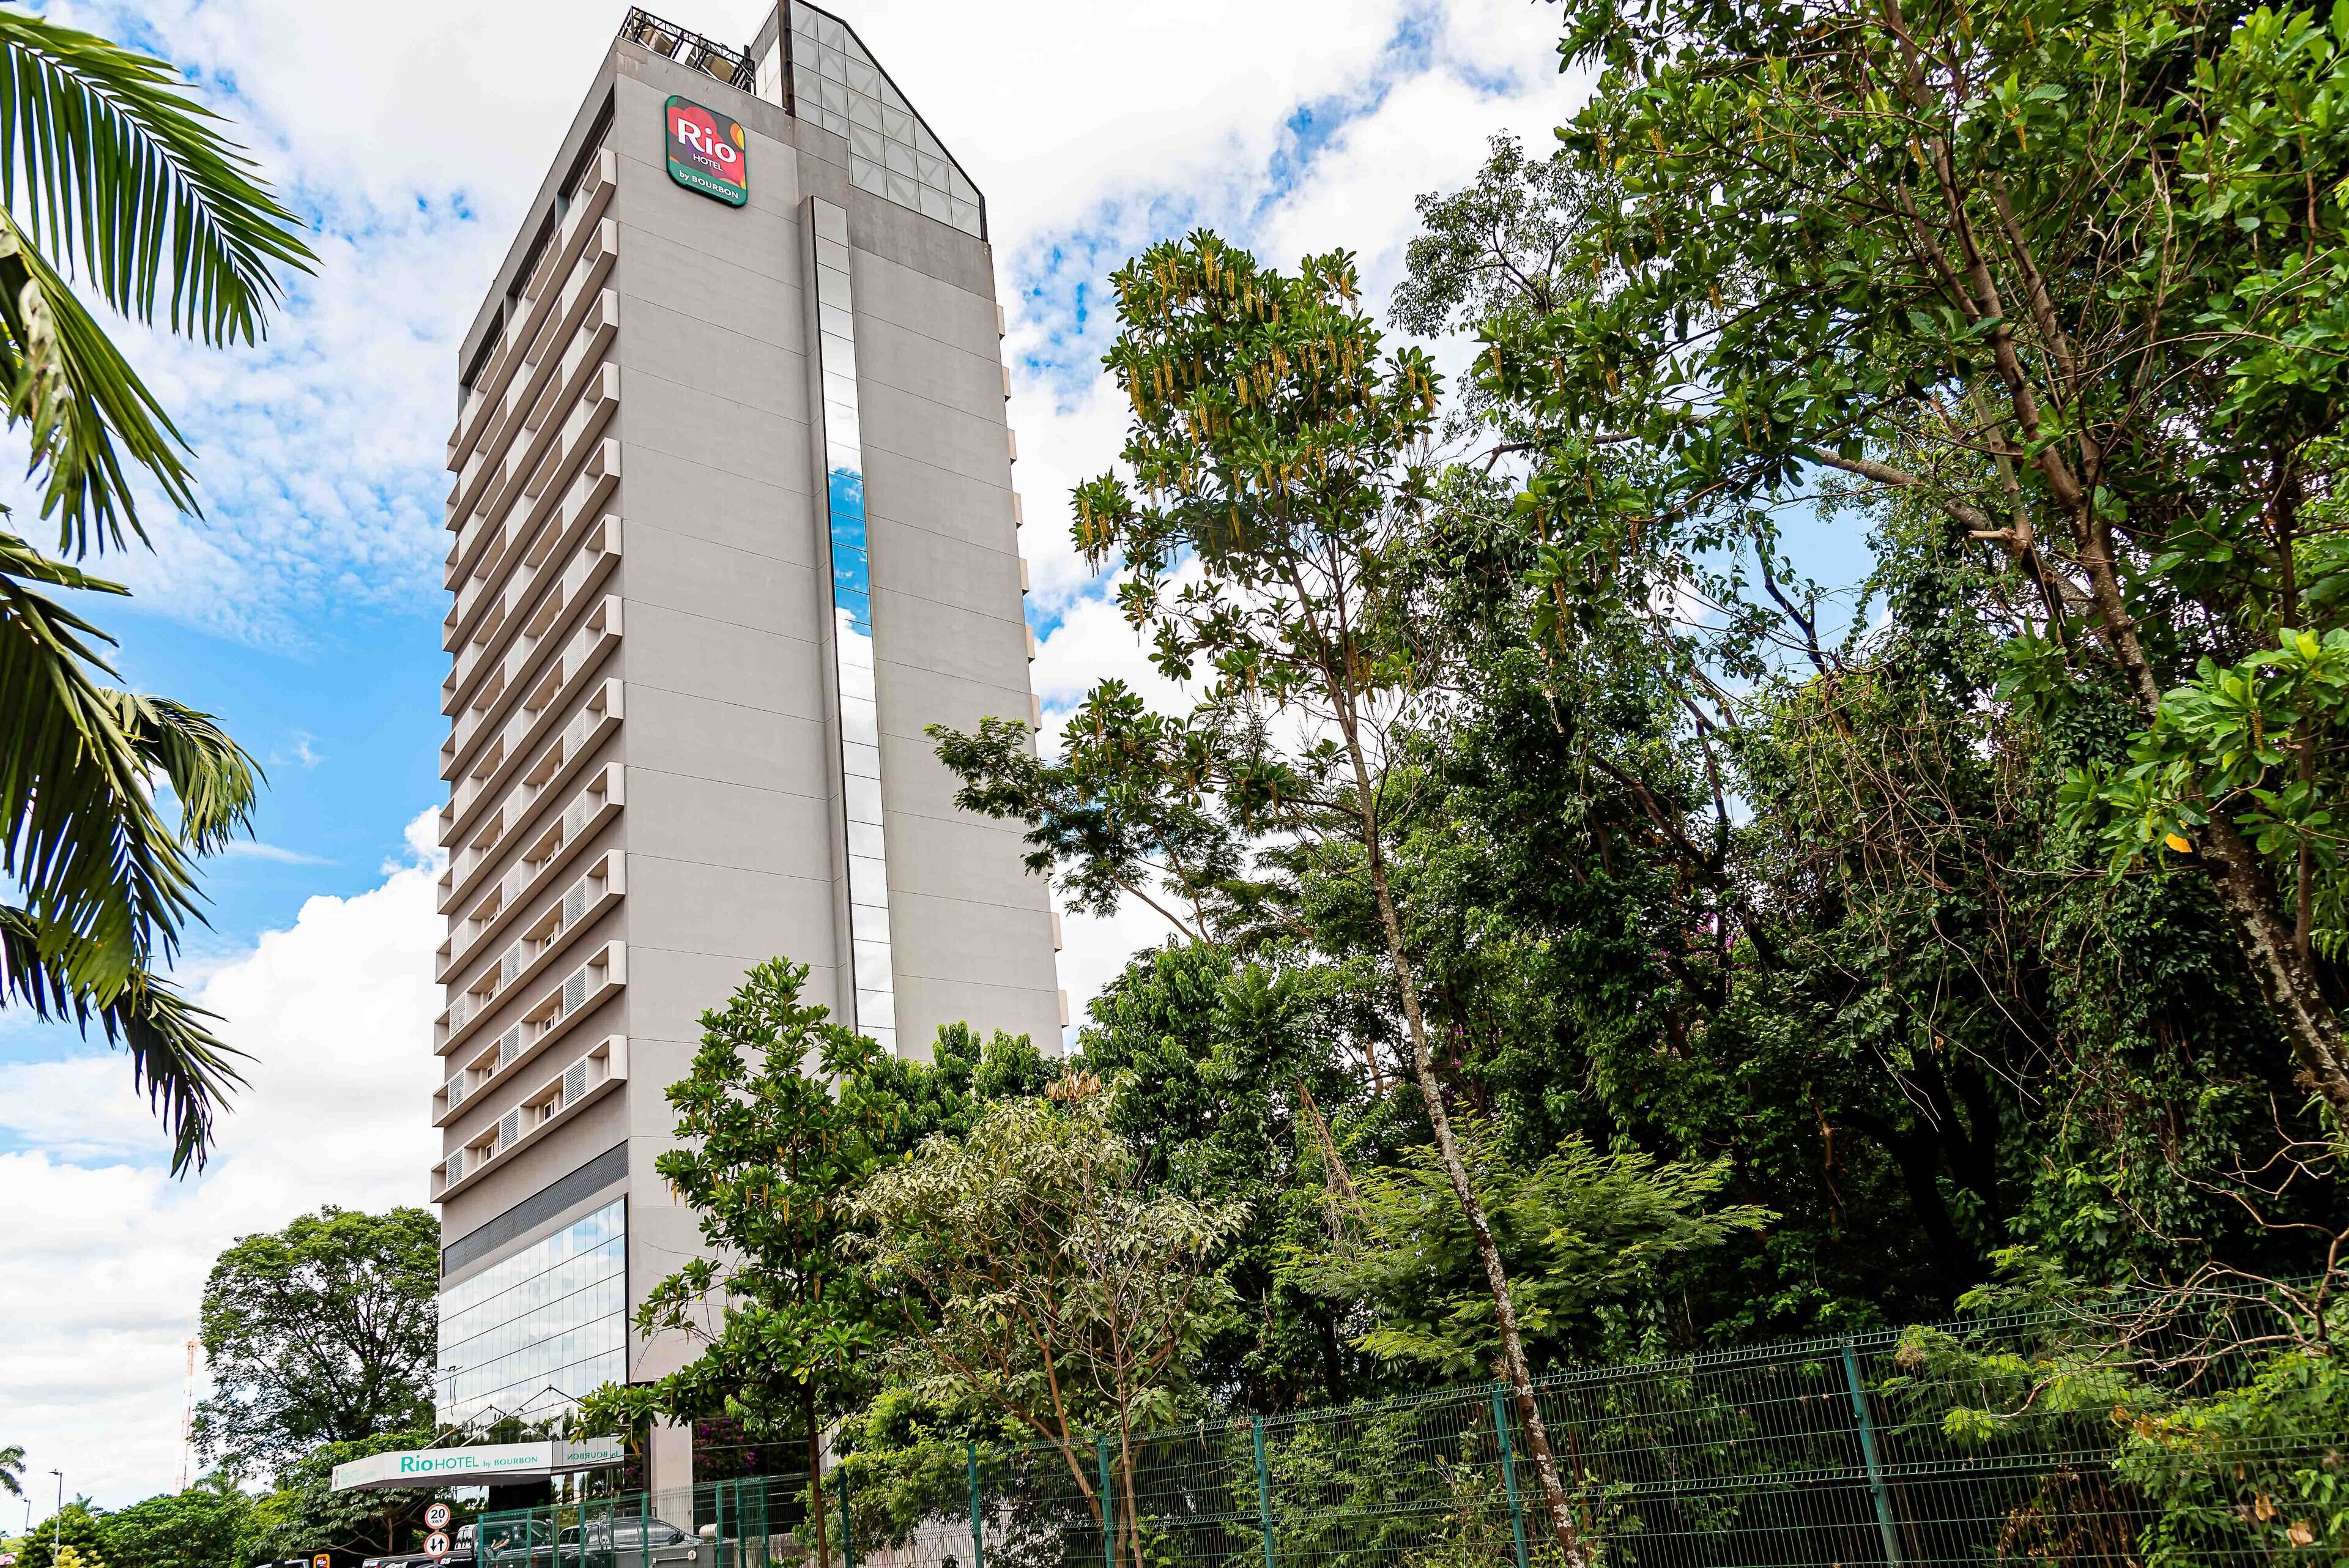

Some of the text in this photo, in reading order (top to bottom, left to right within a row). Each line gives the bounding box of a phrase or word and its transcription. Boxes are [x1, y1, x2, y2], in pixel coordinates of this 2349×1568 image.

[677, 117, 737, 163] Rio
[692, 153, 723, 171] HOTEL
[679, 170, 739, 199] by BOURBON
[494, 1456, 538, 1466] BOURBON
[431, 1509, 445, 1519] 20
